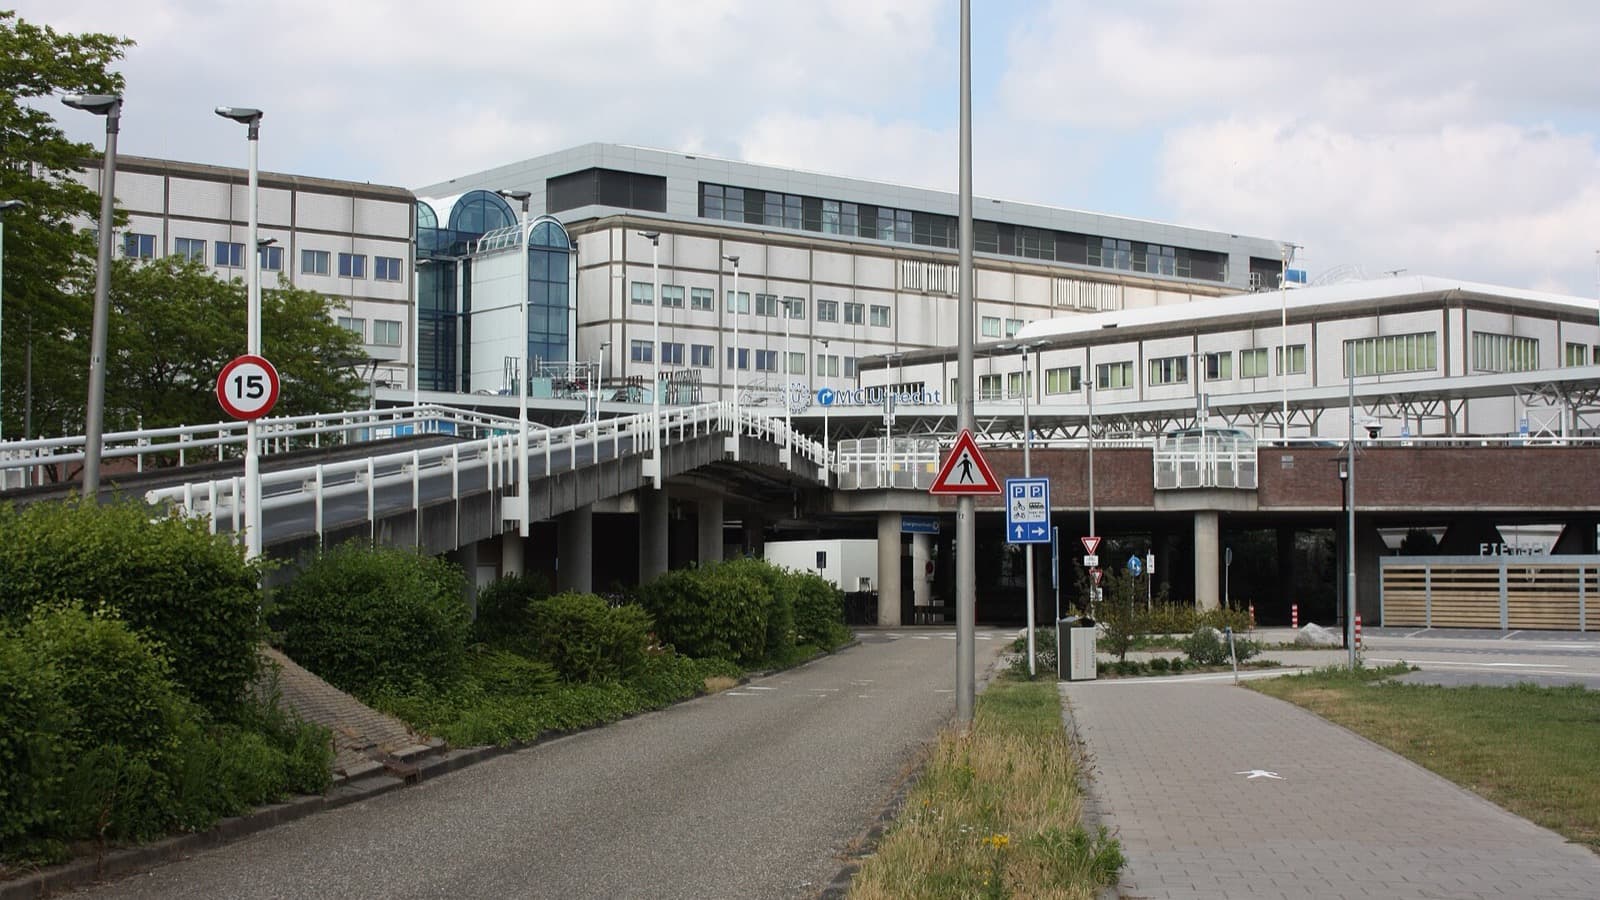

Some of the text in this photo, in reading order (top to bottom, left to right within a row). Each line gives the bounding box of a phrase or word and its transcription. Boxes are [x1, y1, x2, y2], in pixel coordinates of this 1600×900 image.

[234, 376, 264, 399] 15
[1015, 487, 1023, 497] P
[1032, 486, 1040, 497] P
